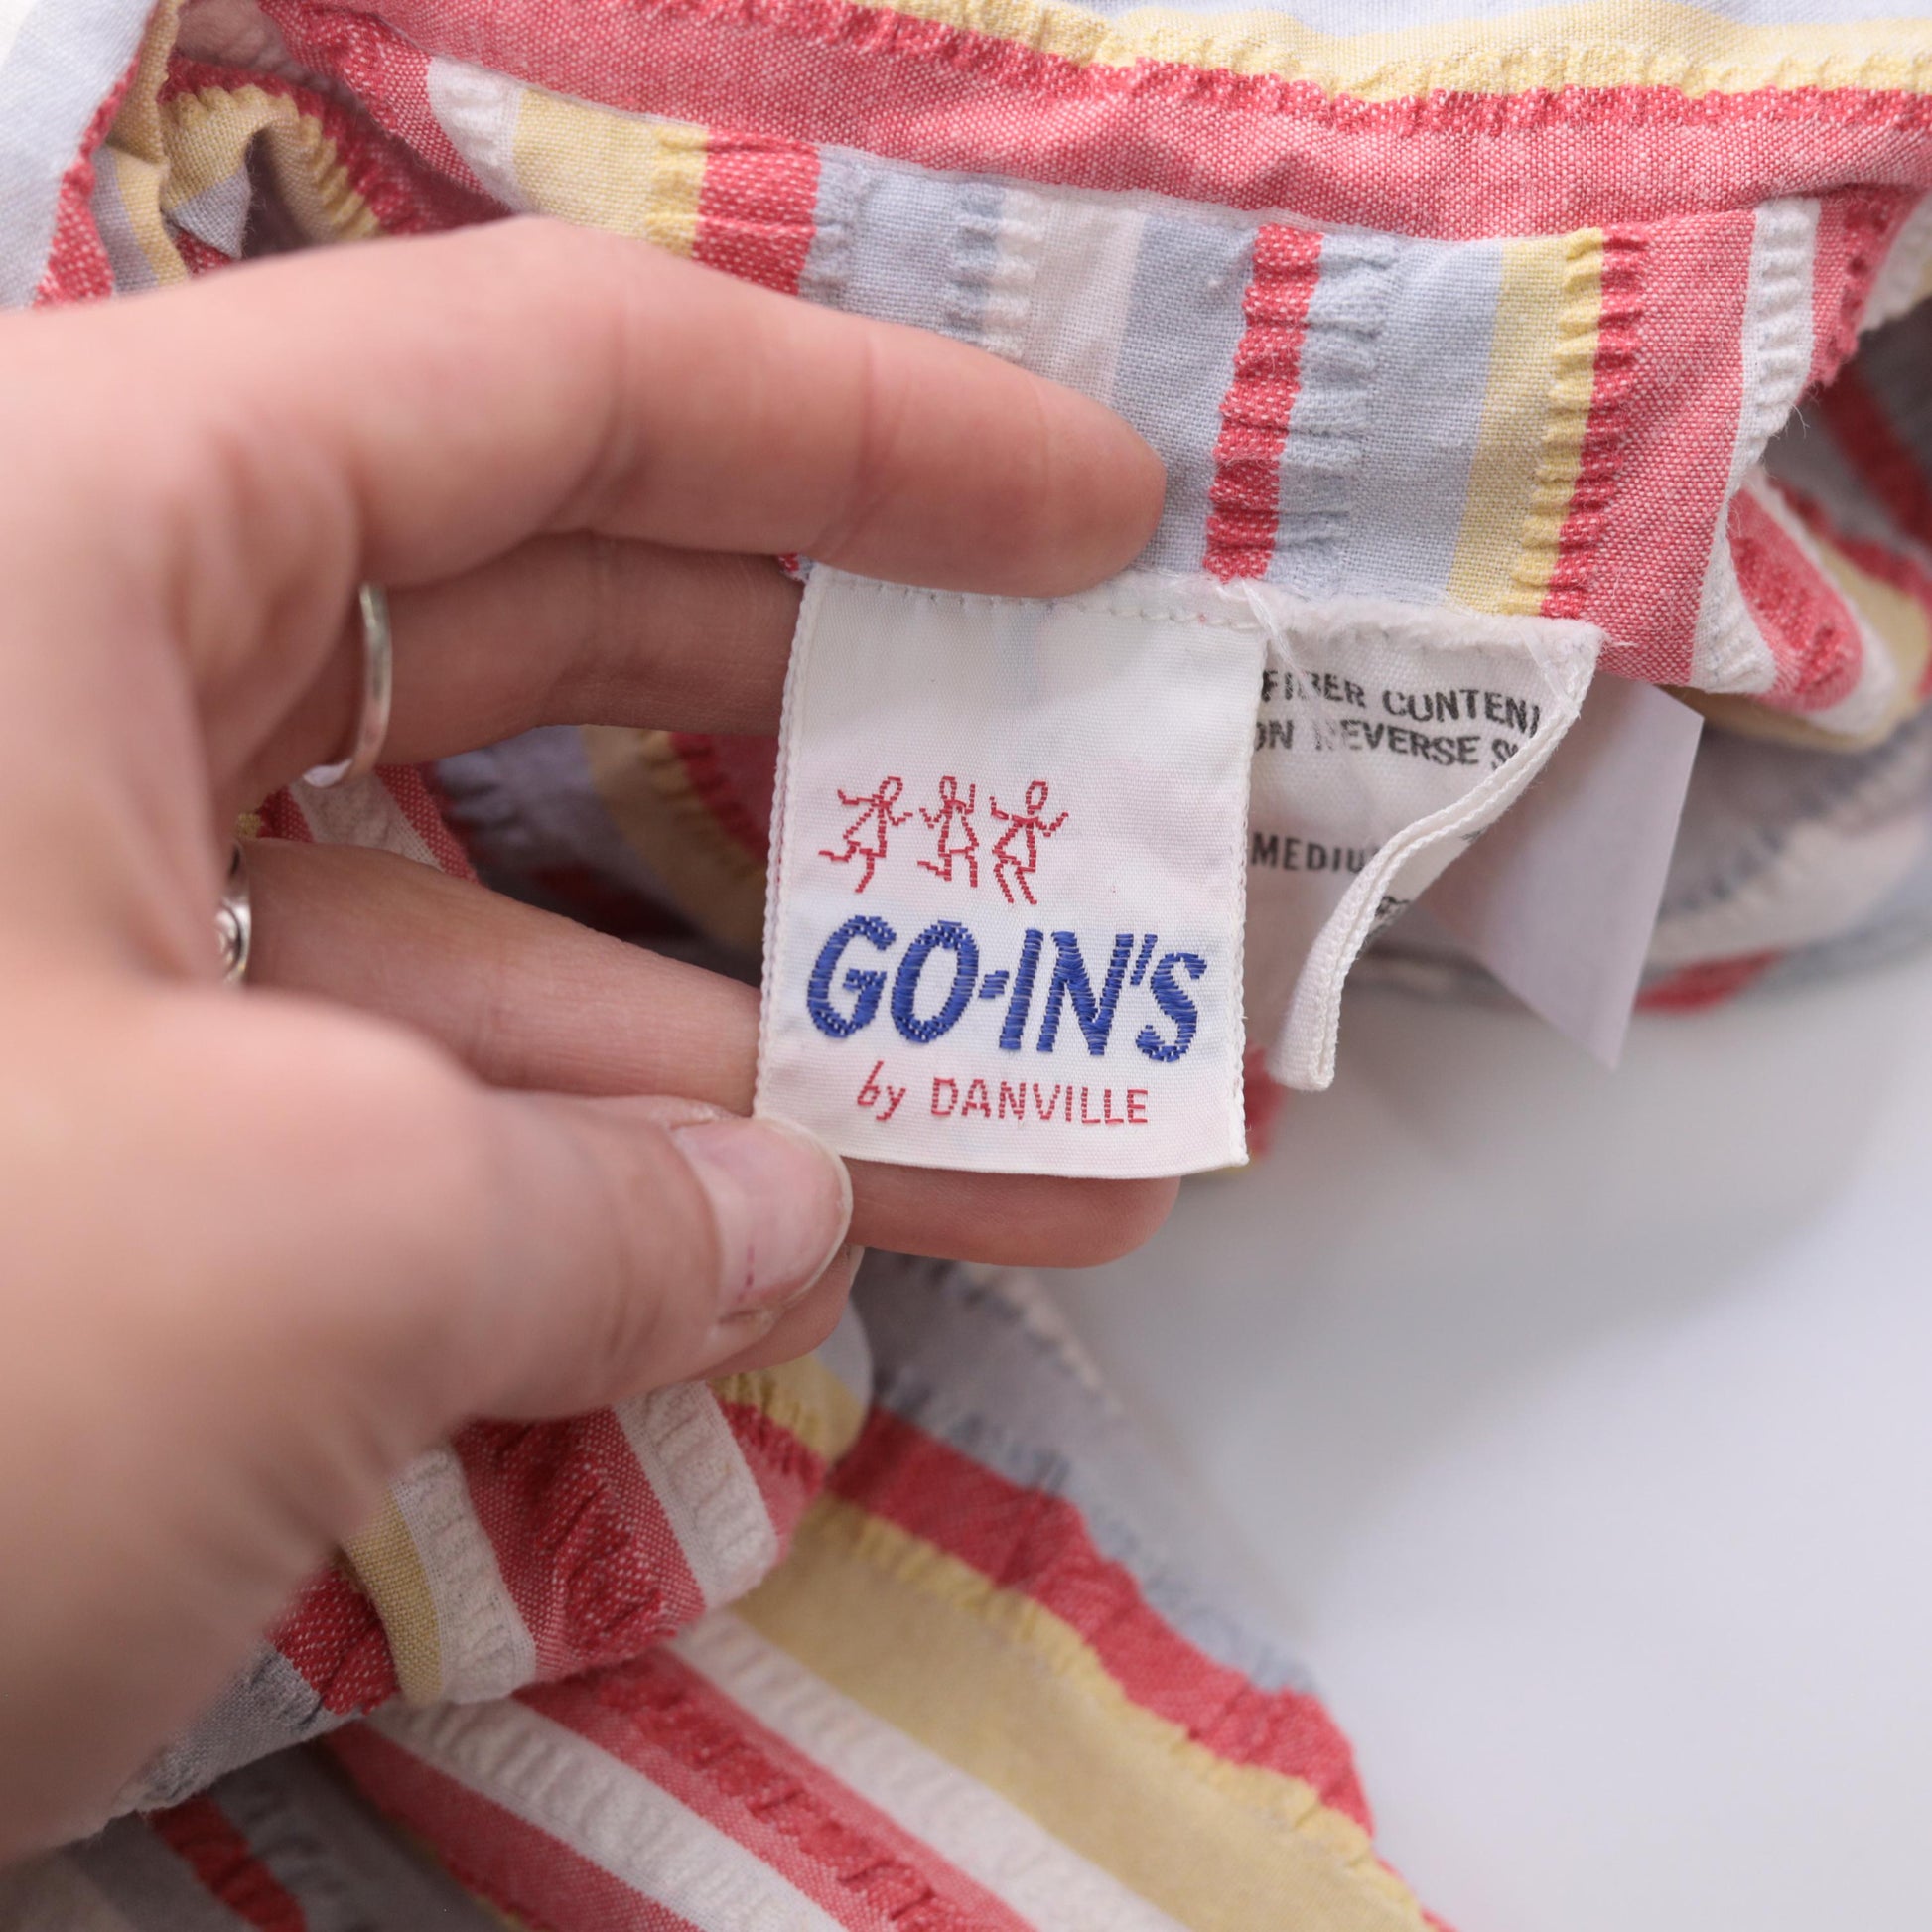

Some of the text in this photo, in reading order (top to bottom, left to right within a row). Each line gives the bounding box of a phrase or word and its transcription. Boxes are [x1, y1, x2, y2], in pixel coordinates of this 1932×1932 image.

[1251, 831, 1381, 875] MEDIU
[857, 1060, 1149, 1124] by DANVILLE
